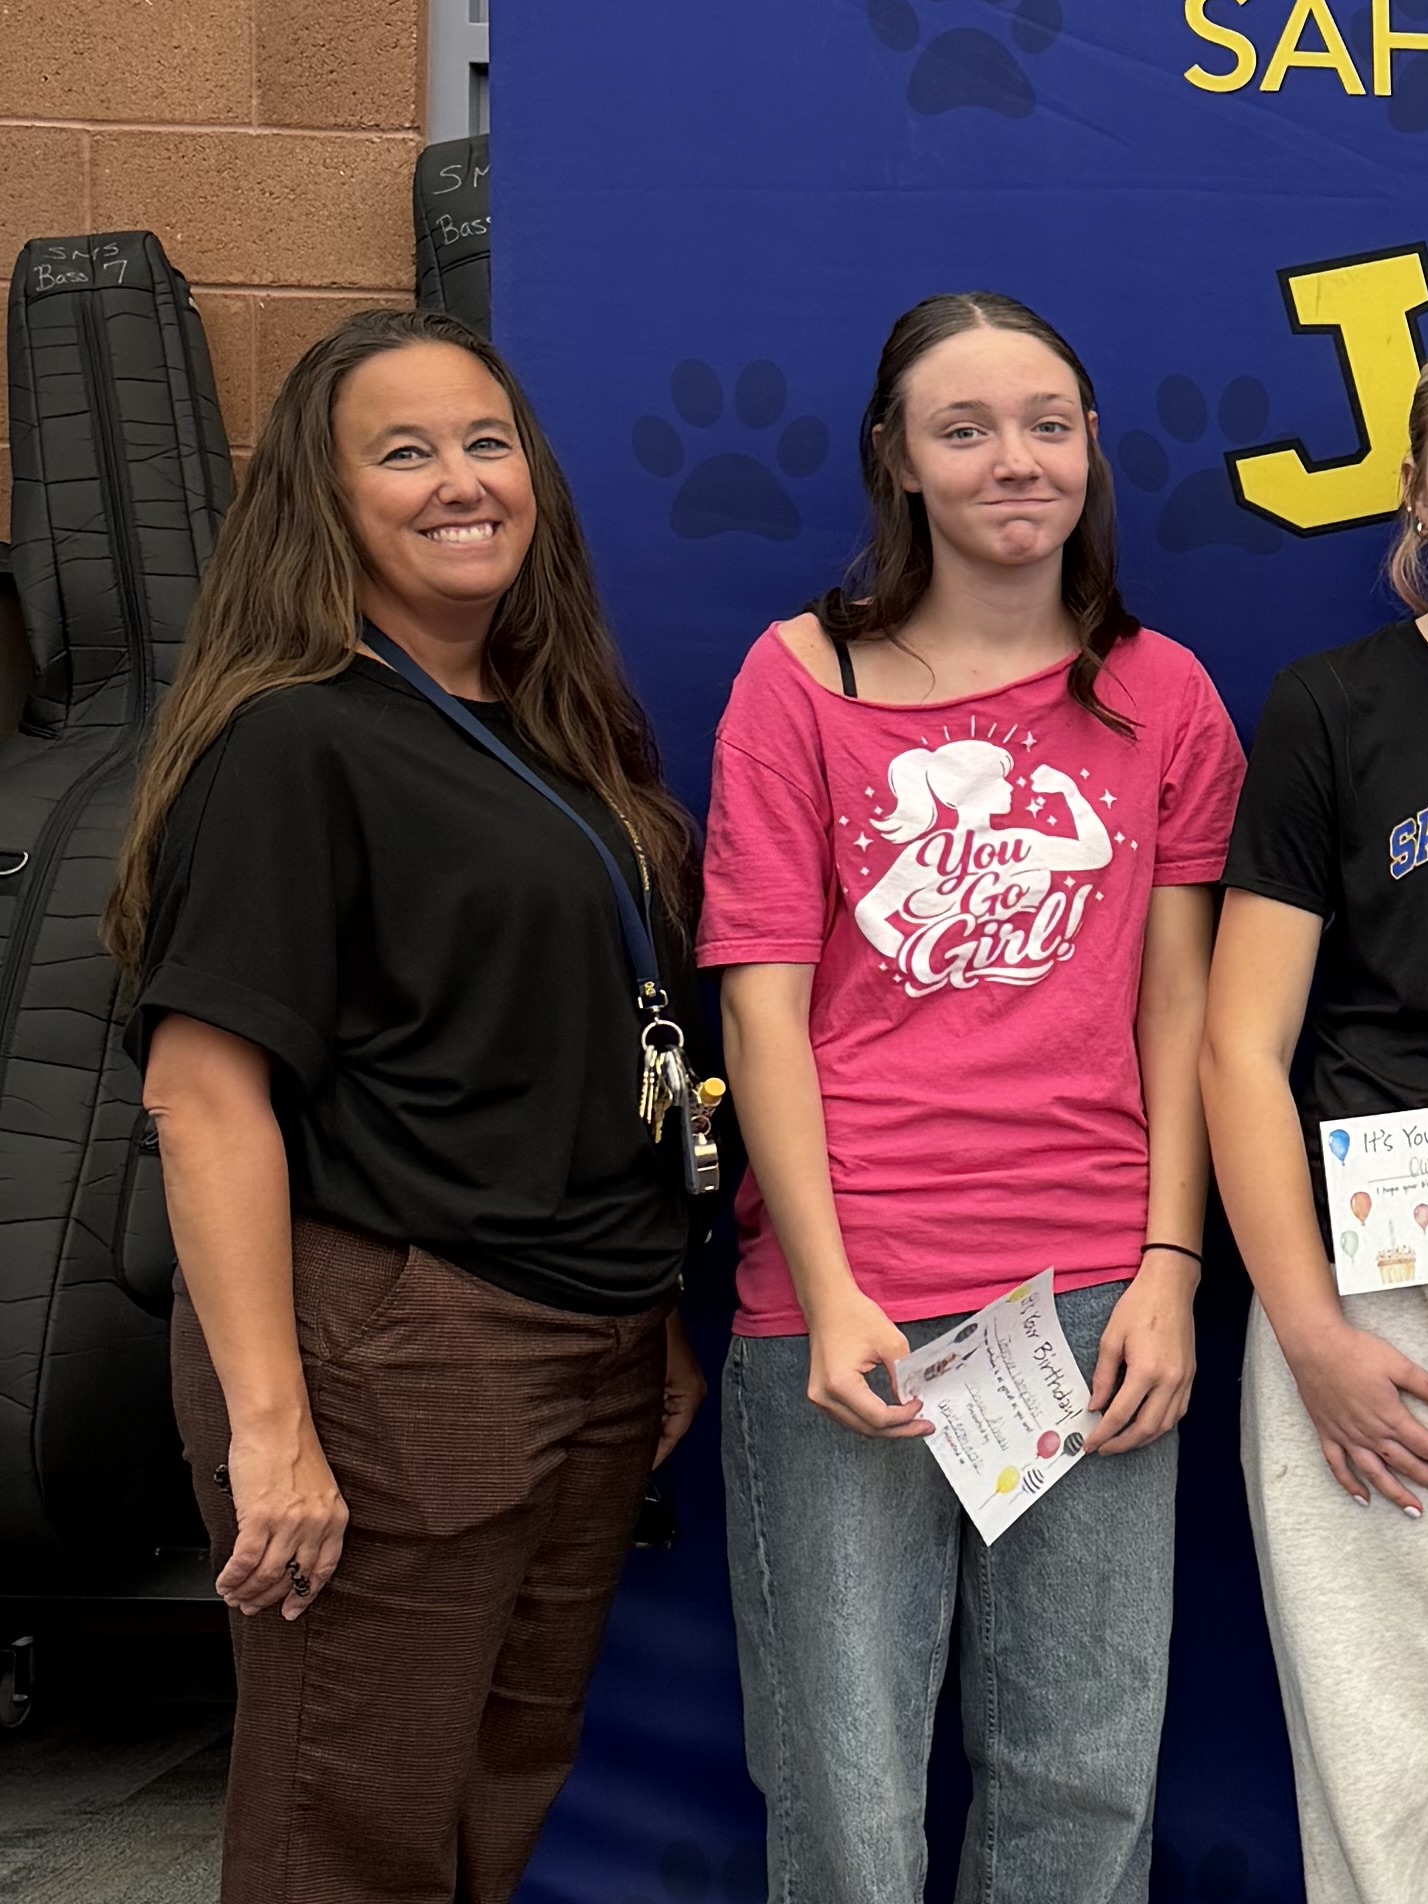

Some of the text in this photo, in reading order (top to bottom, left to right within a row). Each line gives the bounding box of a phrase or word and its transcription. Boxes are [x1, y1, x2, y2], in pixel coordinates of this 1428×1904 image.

[34, 259, 128, 292] Bass 7
[915, 830, 1031, 896] You
[960, 872, 1031, 917] Go
[911, 884, 1093, 989] Girl!
[1363, 1129, 1394, 1153] It's
[1033, 1340, 1083, 1425] Birthday!
